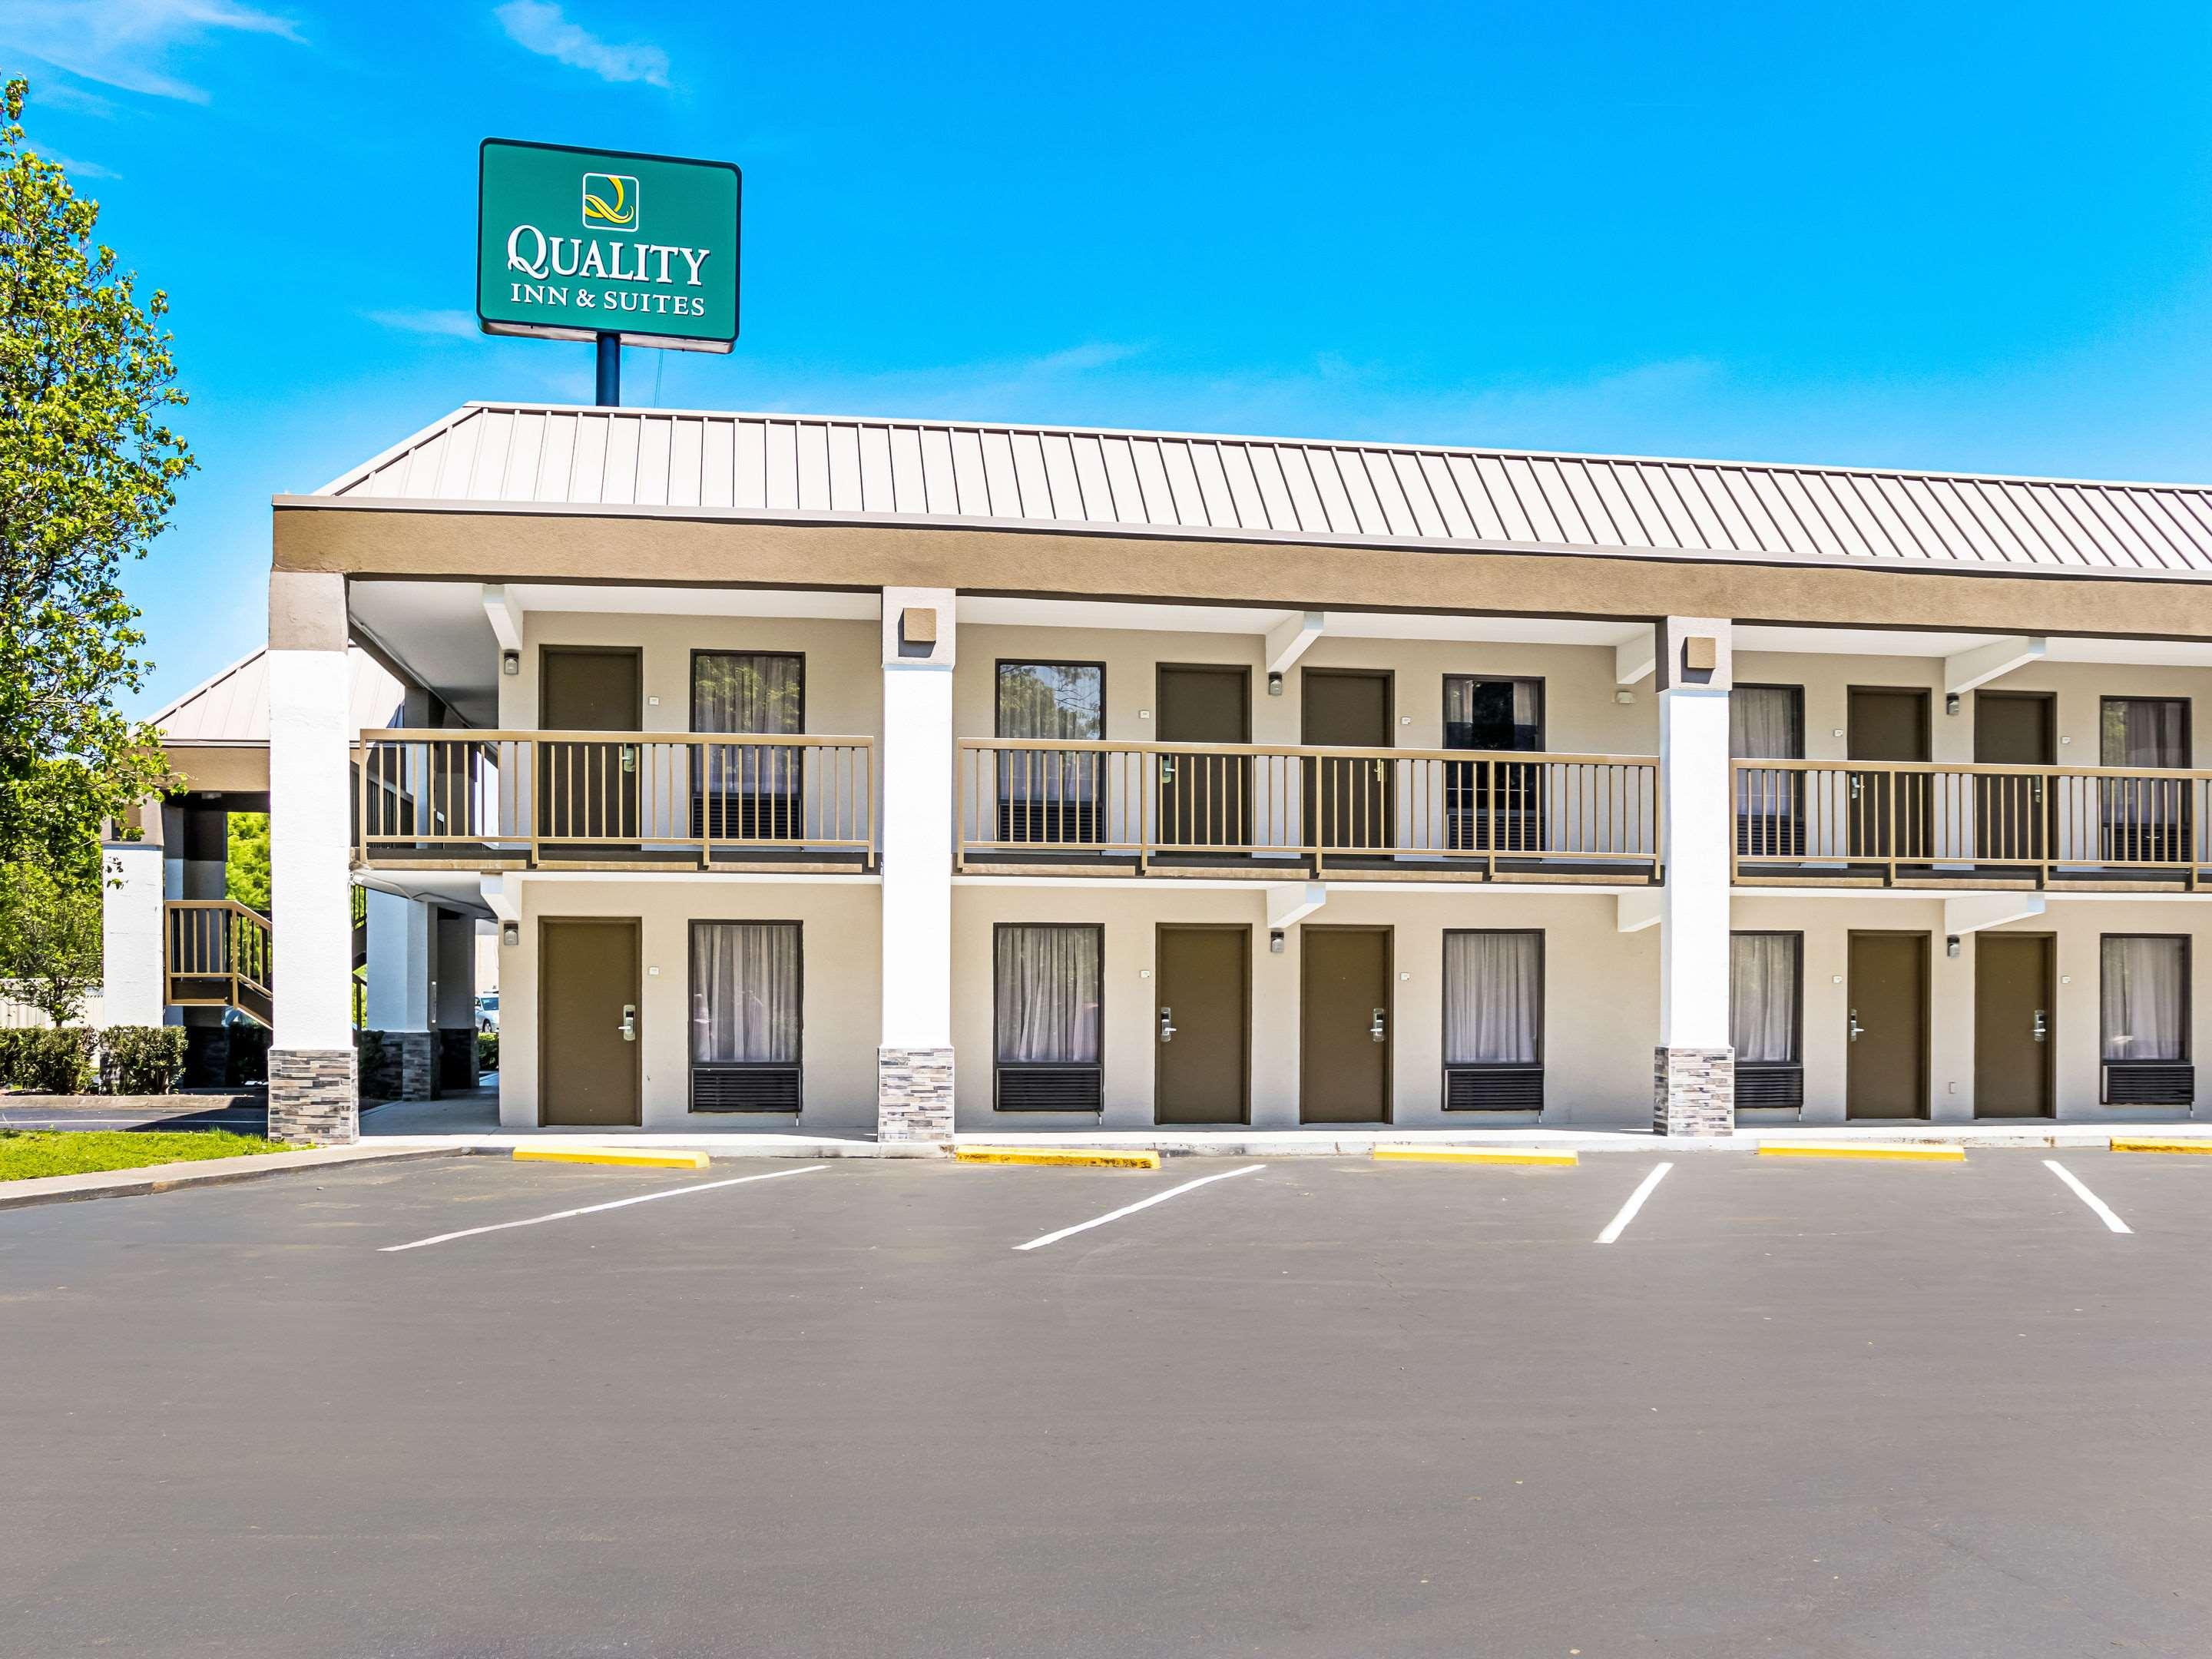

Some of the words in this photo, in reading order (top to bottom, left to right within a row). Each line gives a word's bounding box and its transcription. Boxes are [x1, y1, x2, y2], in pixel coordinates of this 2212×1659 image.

[507, 224, 710, 286] QUALITY
[511, 283, 568, 306] INN
[576, 289, 595, 308] &
[604, 290, 705, 316] SUITES
